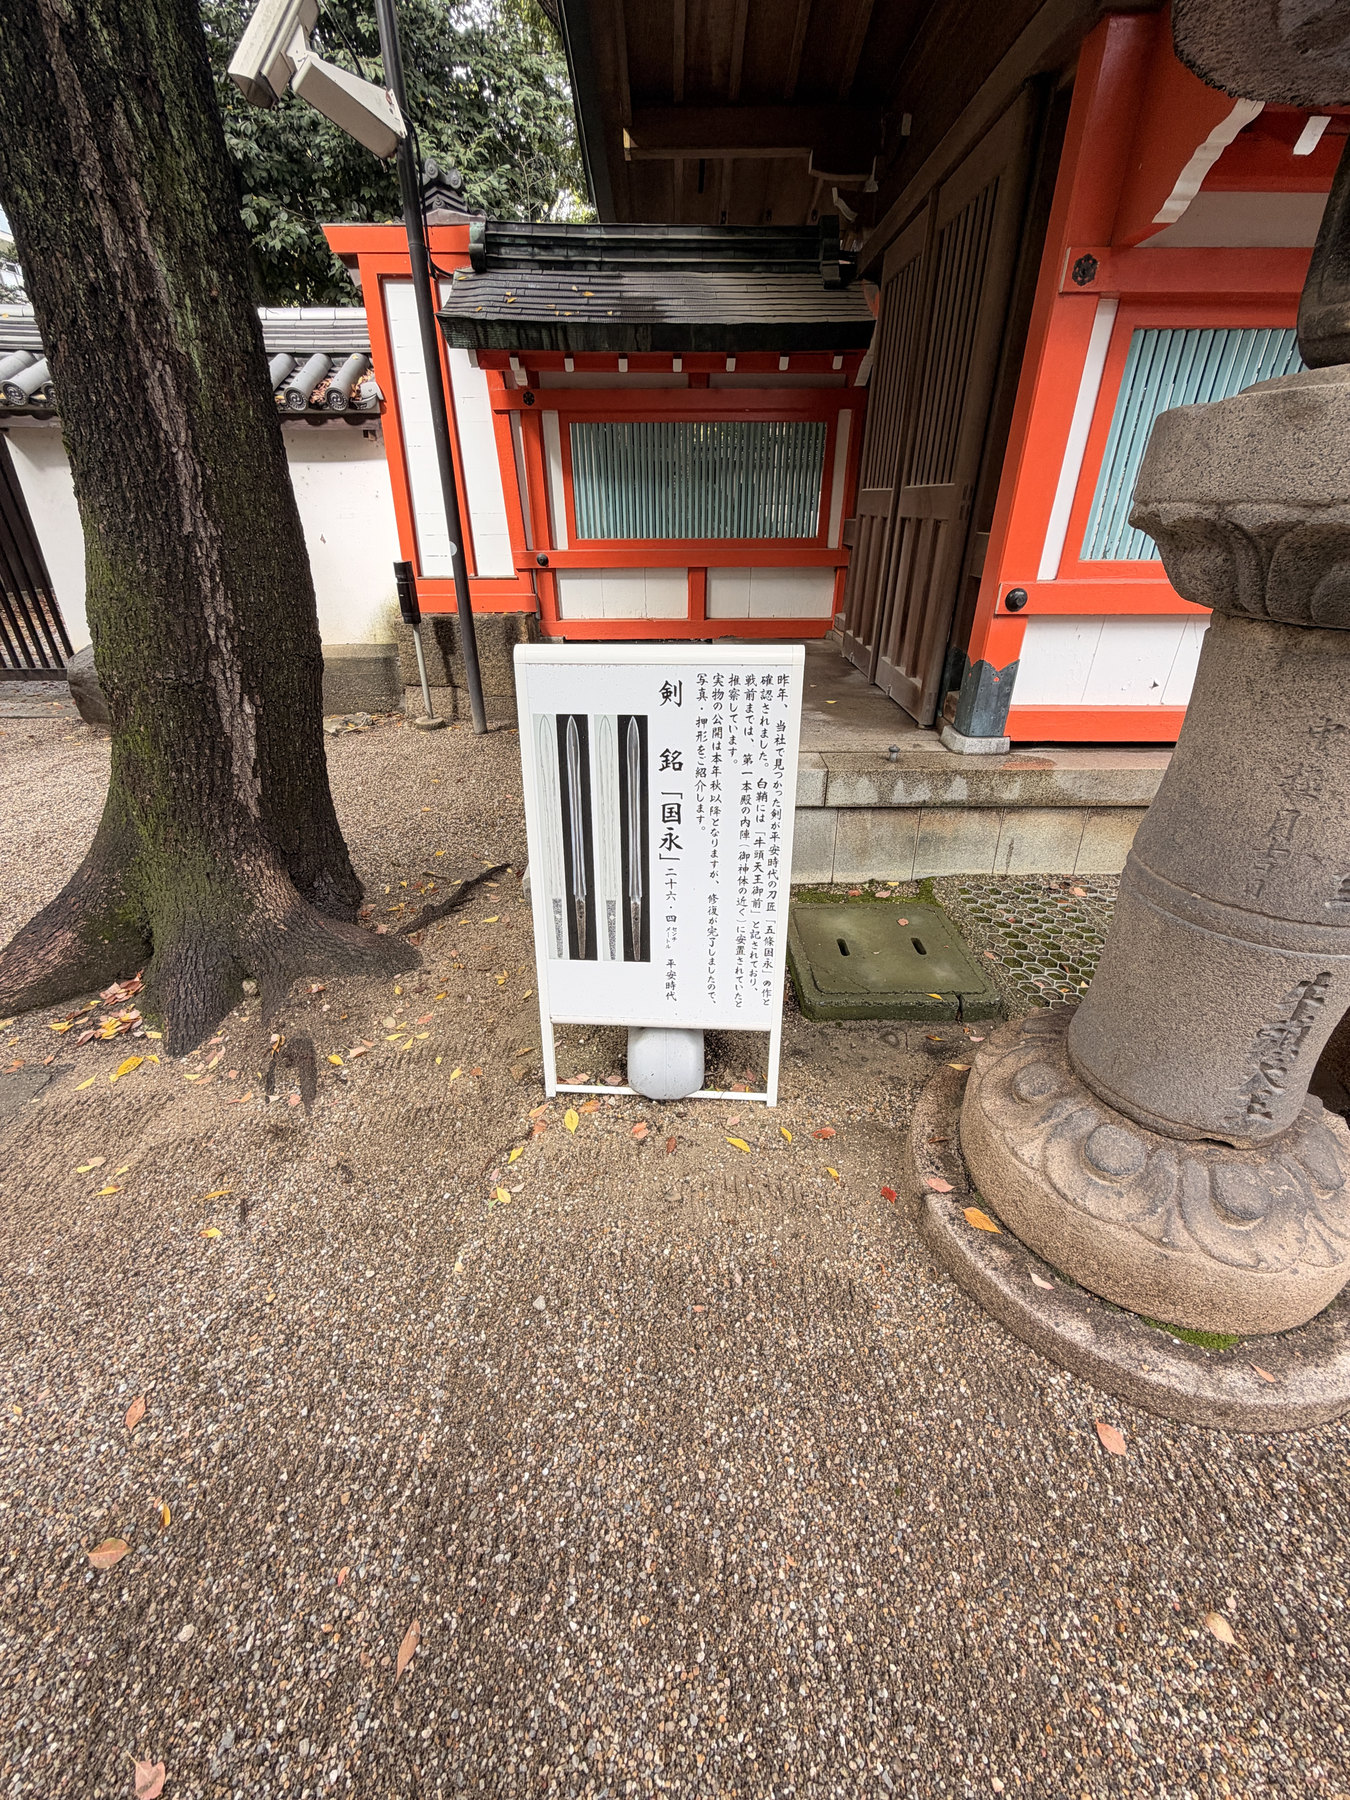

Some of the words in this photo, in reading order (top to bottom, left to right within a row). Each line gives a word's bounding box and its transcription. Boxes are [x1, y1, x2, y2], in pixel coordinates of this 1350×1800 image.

[658, 679, 683, 708] 剣
[727, 673, 741, 764] 推察しています。
[694, 672, 709, 831] 写真・押形をご紹介します。
[665, 958, 677, 1002] 平安時代
